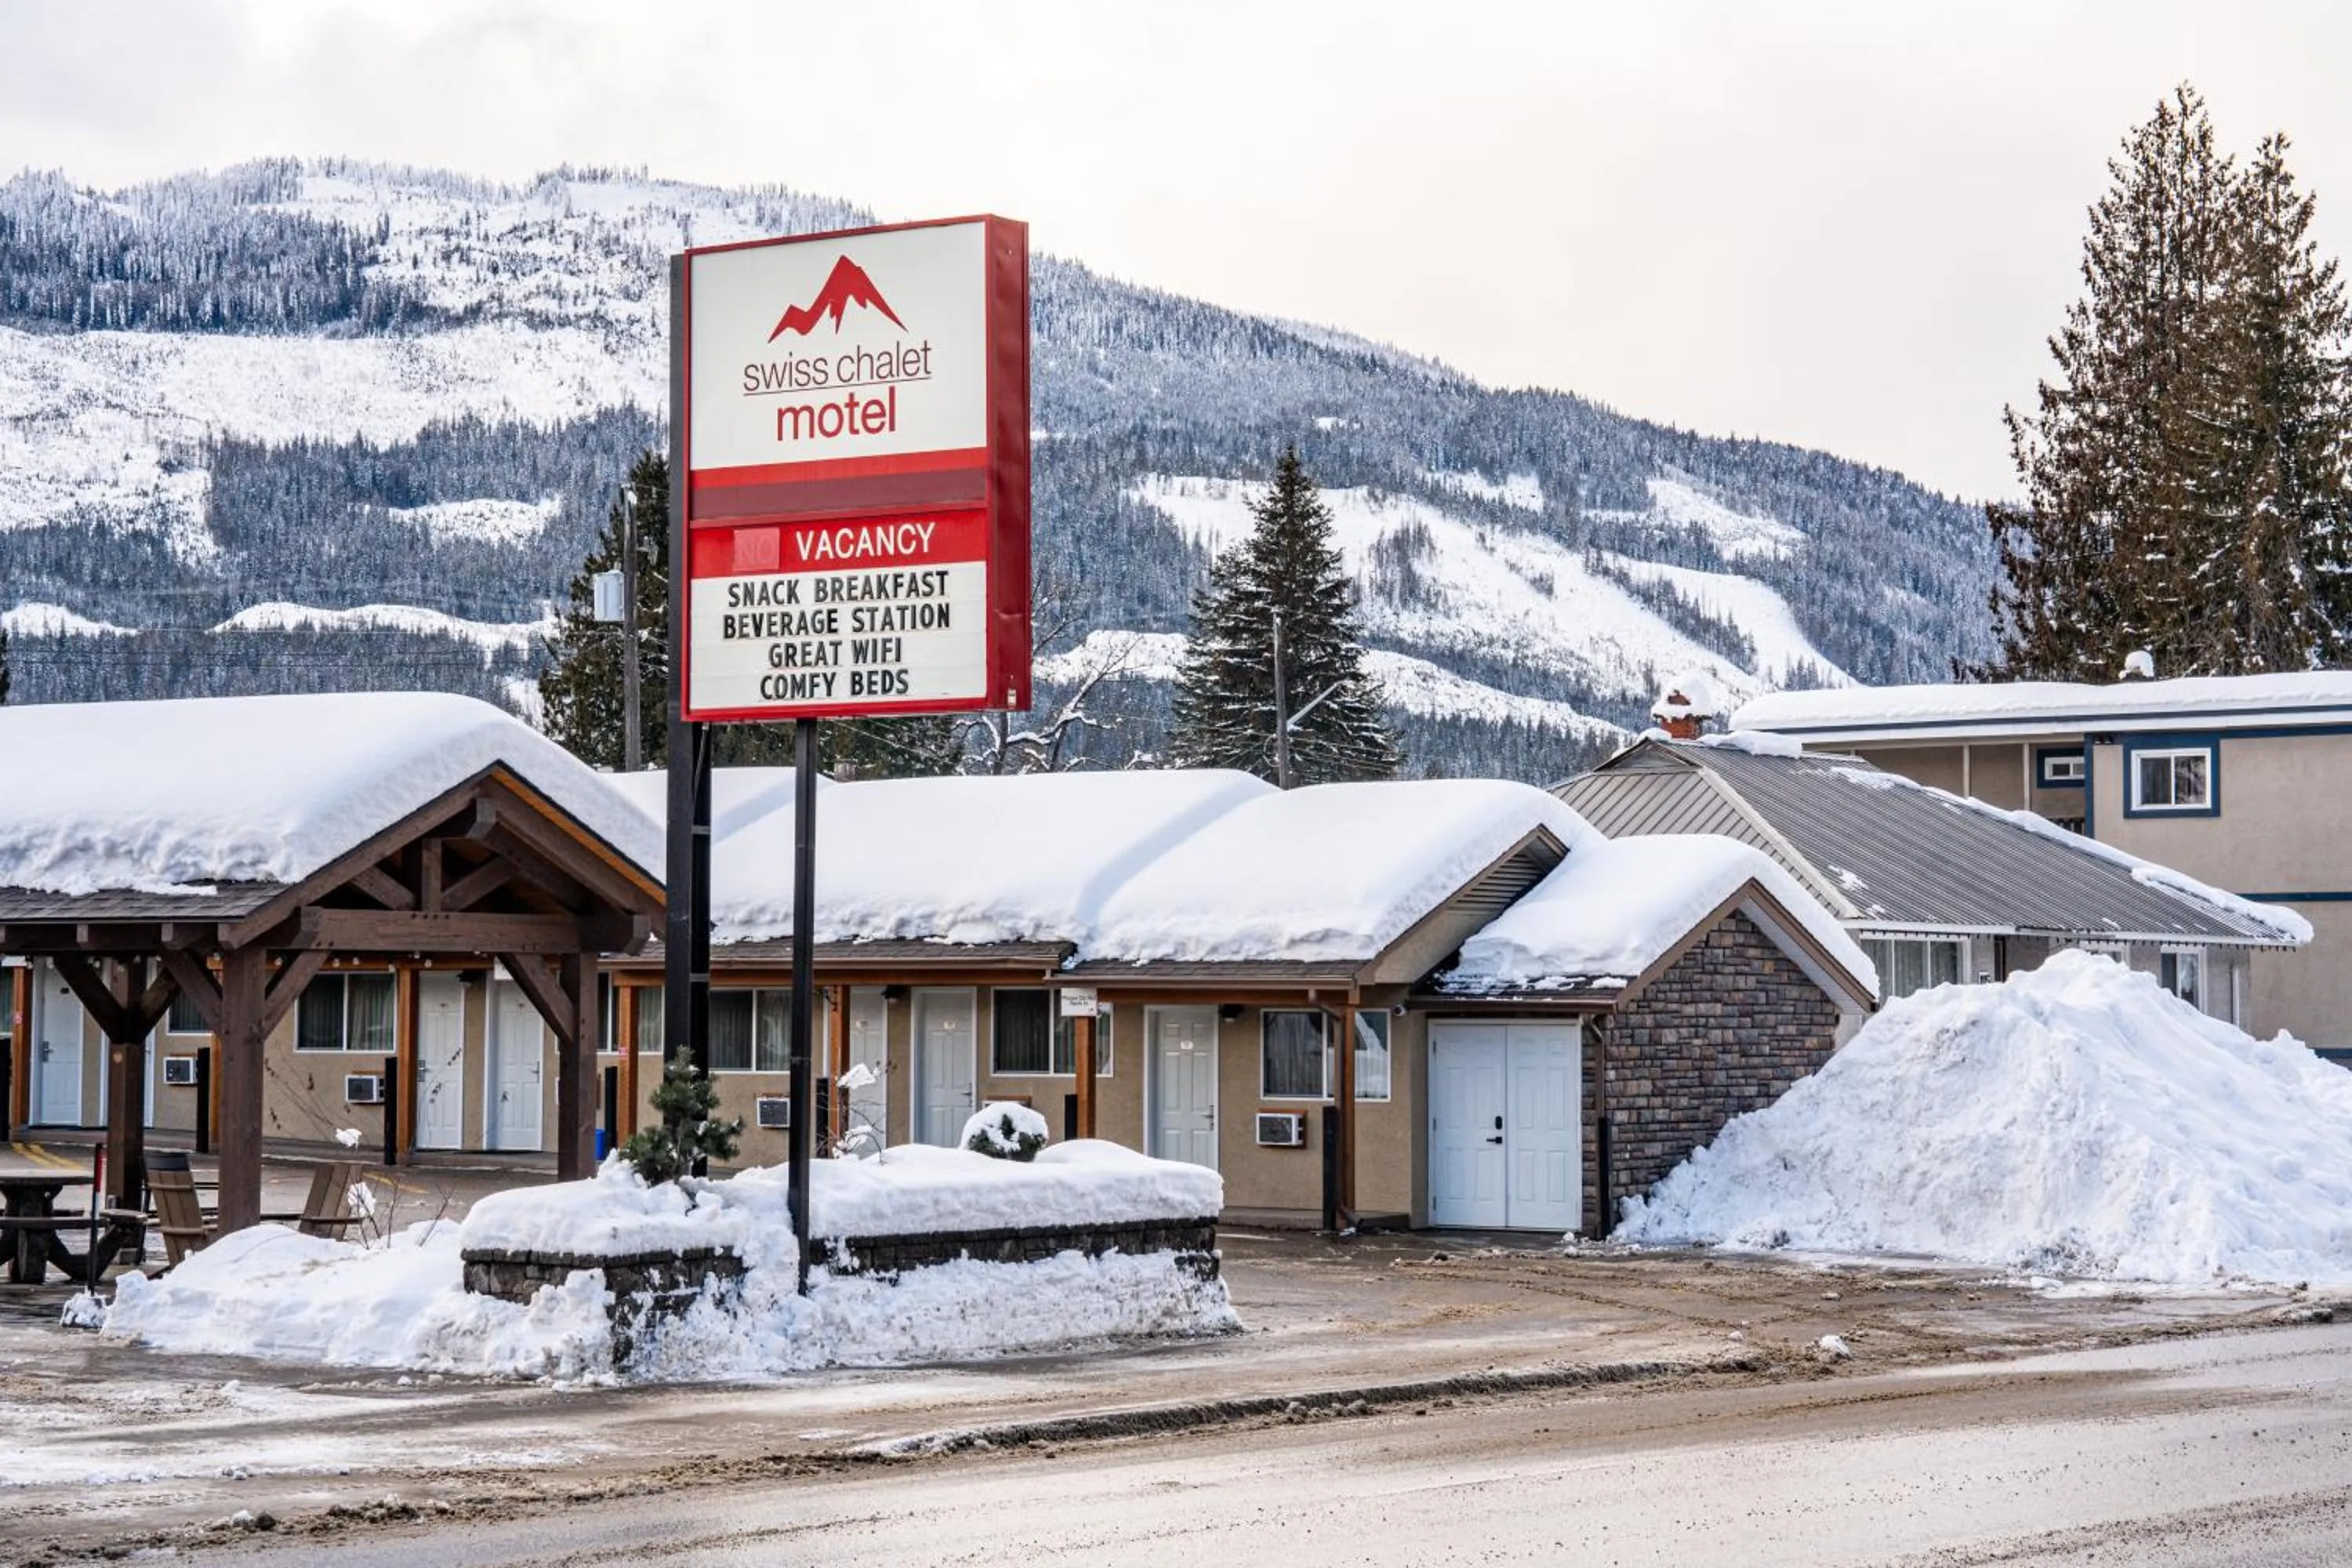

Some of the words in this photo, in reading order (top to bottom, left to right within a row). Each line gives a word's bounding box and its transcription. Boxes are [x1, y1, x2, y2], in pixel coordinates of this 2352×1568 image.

[744, 351, 829, 391] swiss
[837, 340, 932, 383] chalet
[777, 385, 896, 441] motel
[796, 522, 935, 561] VACANCY
[728, 579, 800, 608] SNACK
[815, 571, 949, 603] BREAKFAST
[723, 608, 838, 639] BEVERAGE
[852, 603, 950, 633] STATION
[768, 641, 843, 668] GREAT
[851, 637, 902, 664] WIFI
[760, 672, 837, 700] COMFY
[851, 669, 909, 696] BEDS
